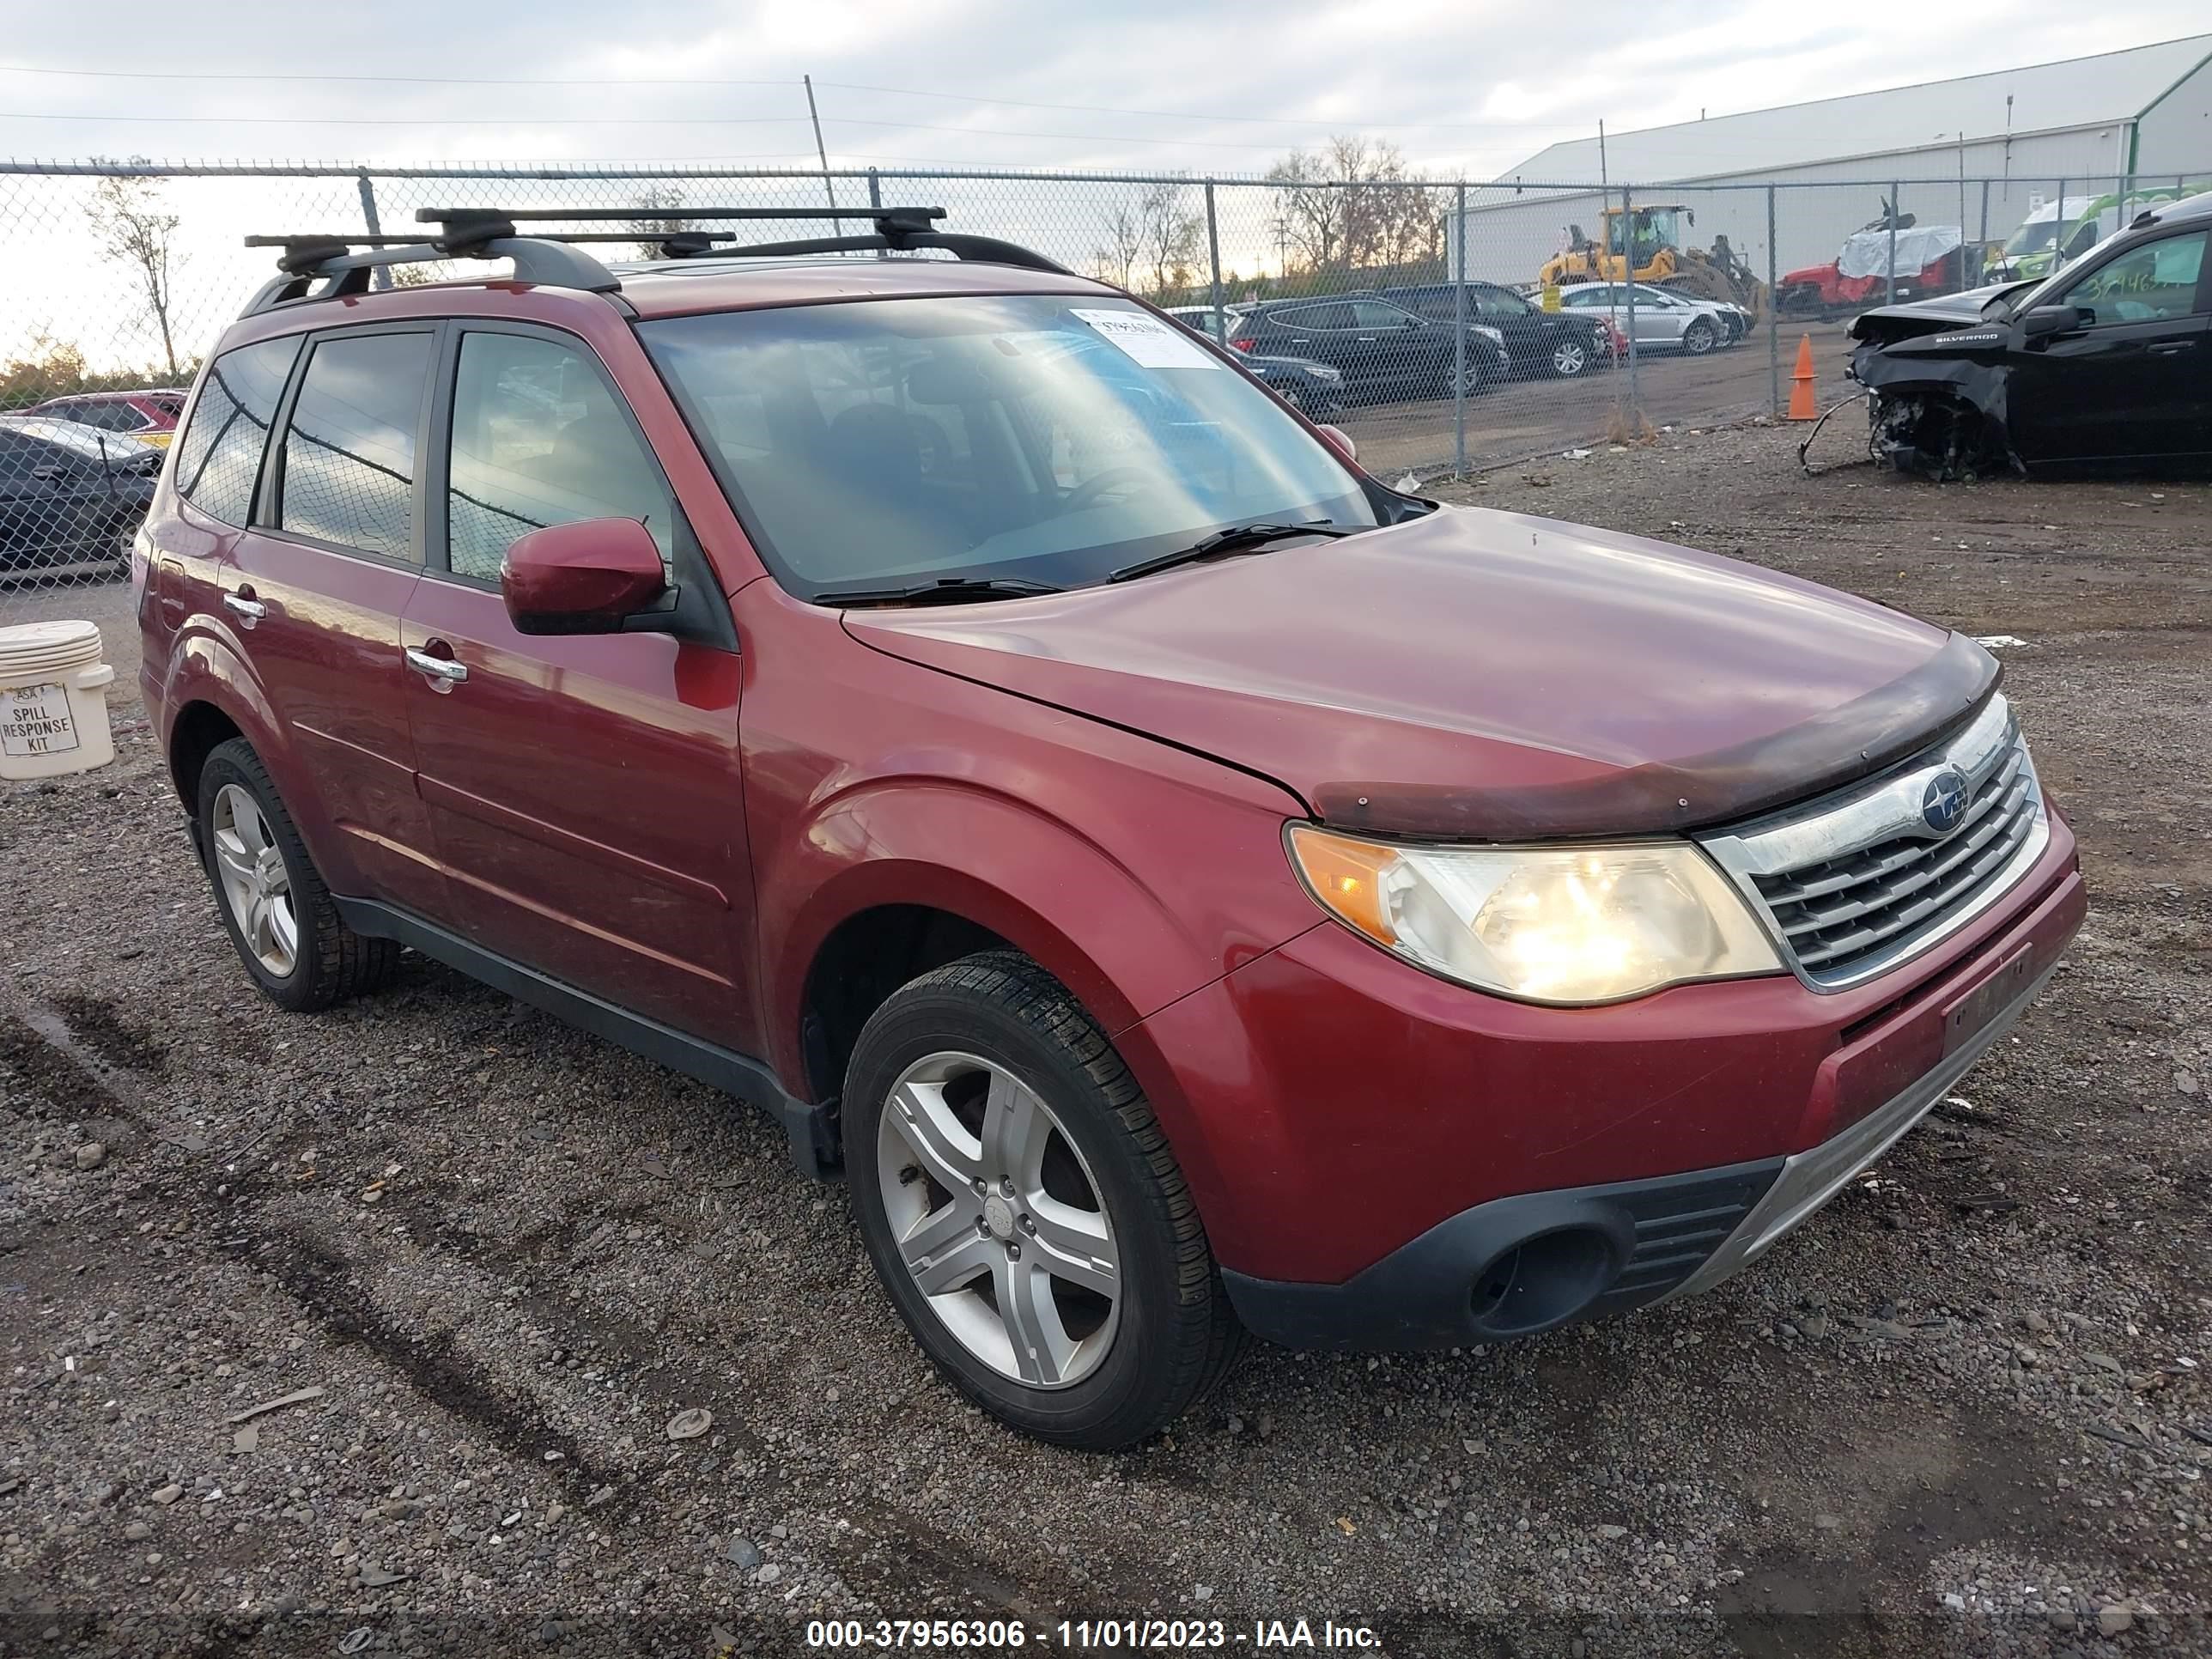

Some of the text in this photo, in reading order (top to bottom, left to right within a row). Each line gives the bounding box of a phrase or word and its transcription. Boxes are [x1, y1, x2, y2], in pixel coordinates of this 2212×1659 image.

[1936, 333, 1998, 343] SILVERADO
[13, 706, 50, 721] SPILL
[3, 718, 70, 737] RESPONSE
[27, 737, 47, 751] KIT
